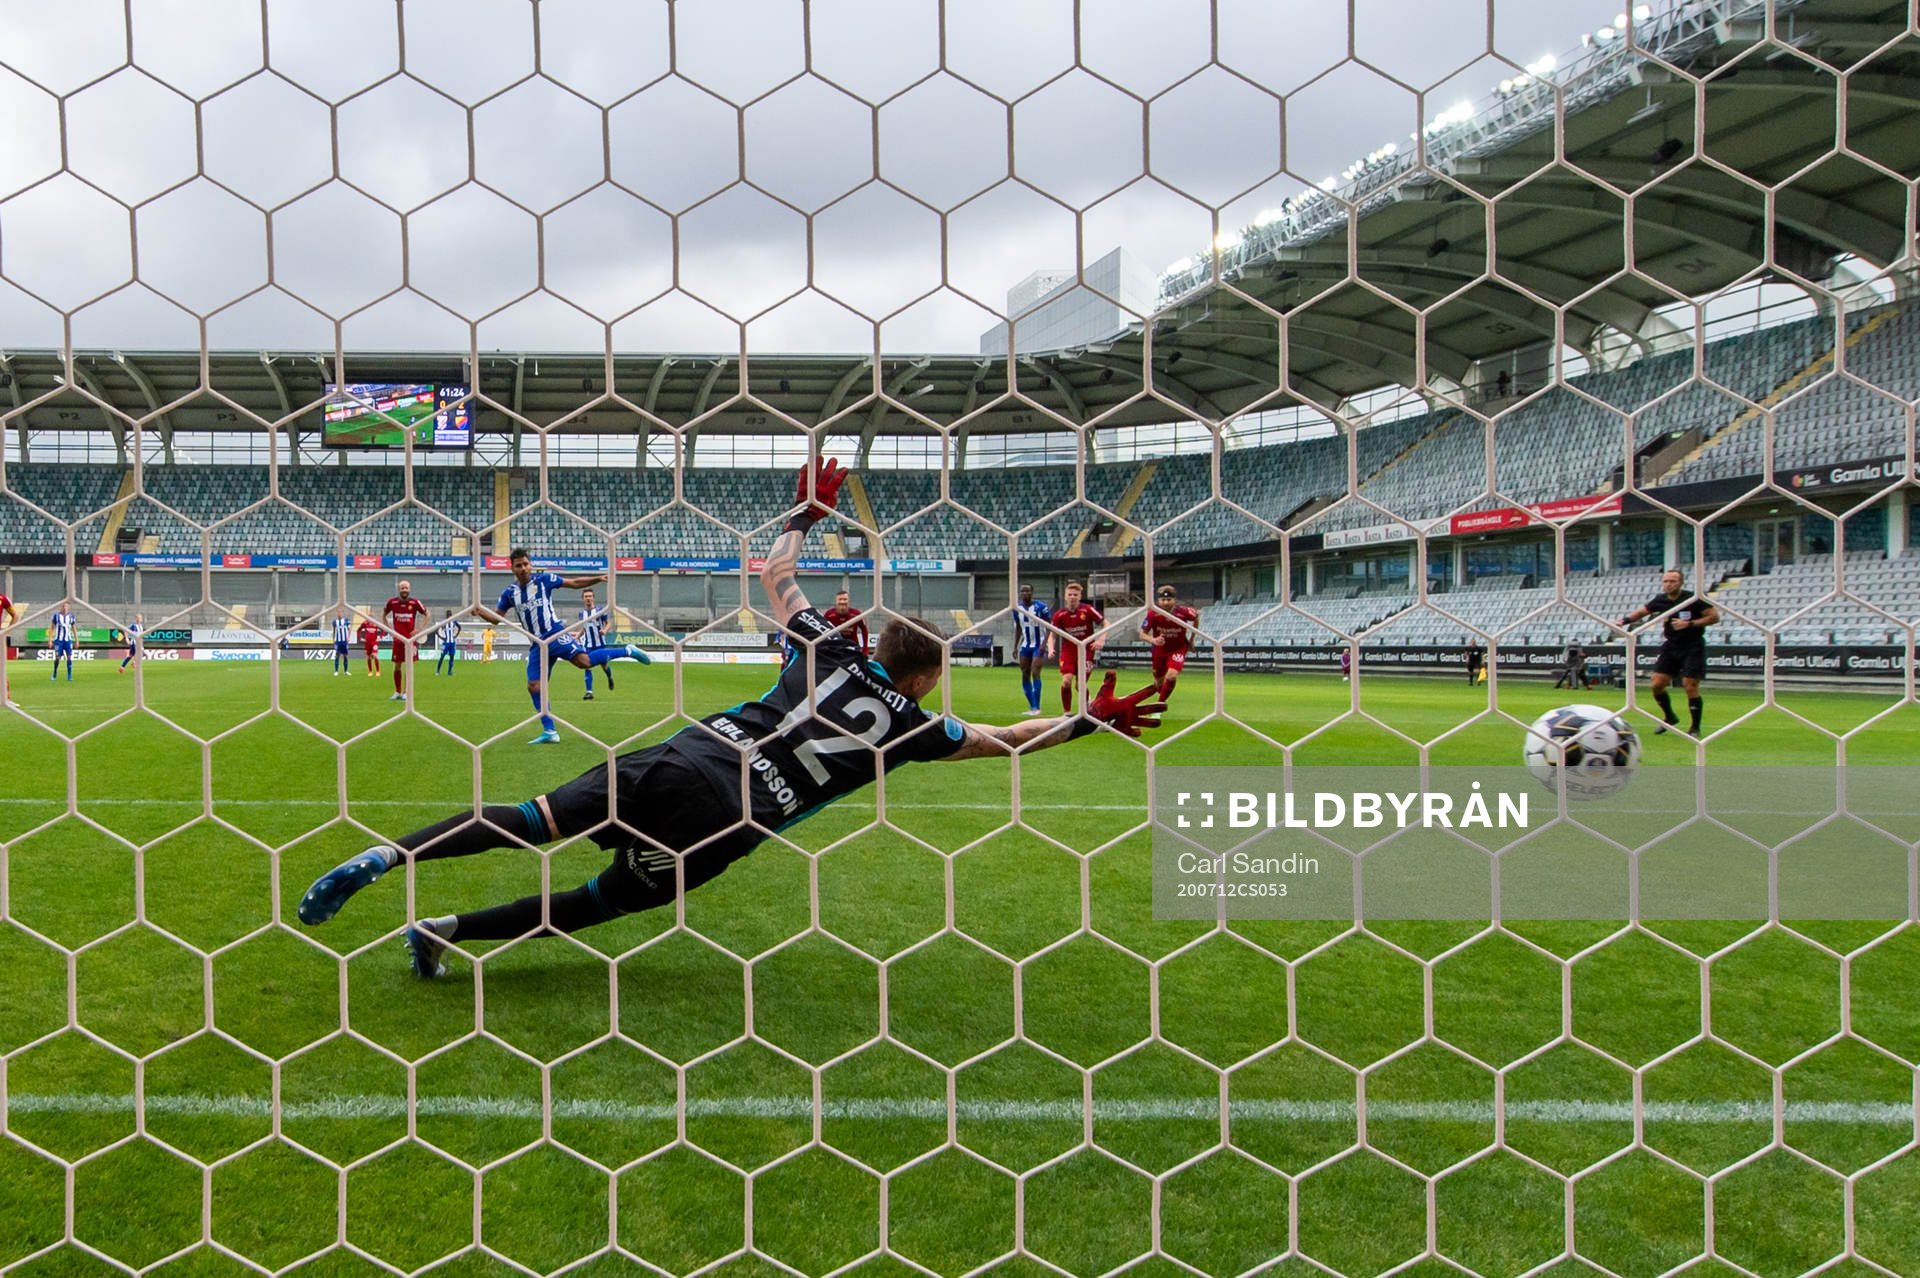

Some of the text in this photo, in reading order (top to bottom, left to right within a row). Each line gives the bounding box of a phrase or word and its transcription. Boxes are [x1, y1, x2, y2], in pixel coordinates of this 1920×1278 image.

[440, 388, 464, 397] 61:24
[1830, 464, 1880, 483] Gamla
[37, 650, 97, 660] SEEKE
[143, 650, 180, 660] YGG
[212, 651, 260, 660] Swegon
[1706, 655, 1732, 666] amla
[1806, 656, 1840, 668] Ullevi
[1848, 656, 1890, 668] Gamla
[776, 667, 892, 786] 12
